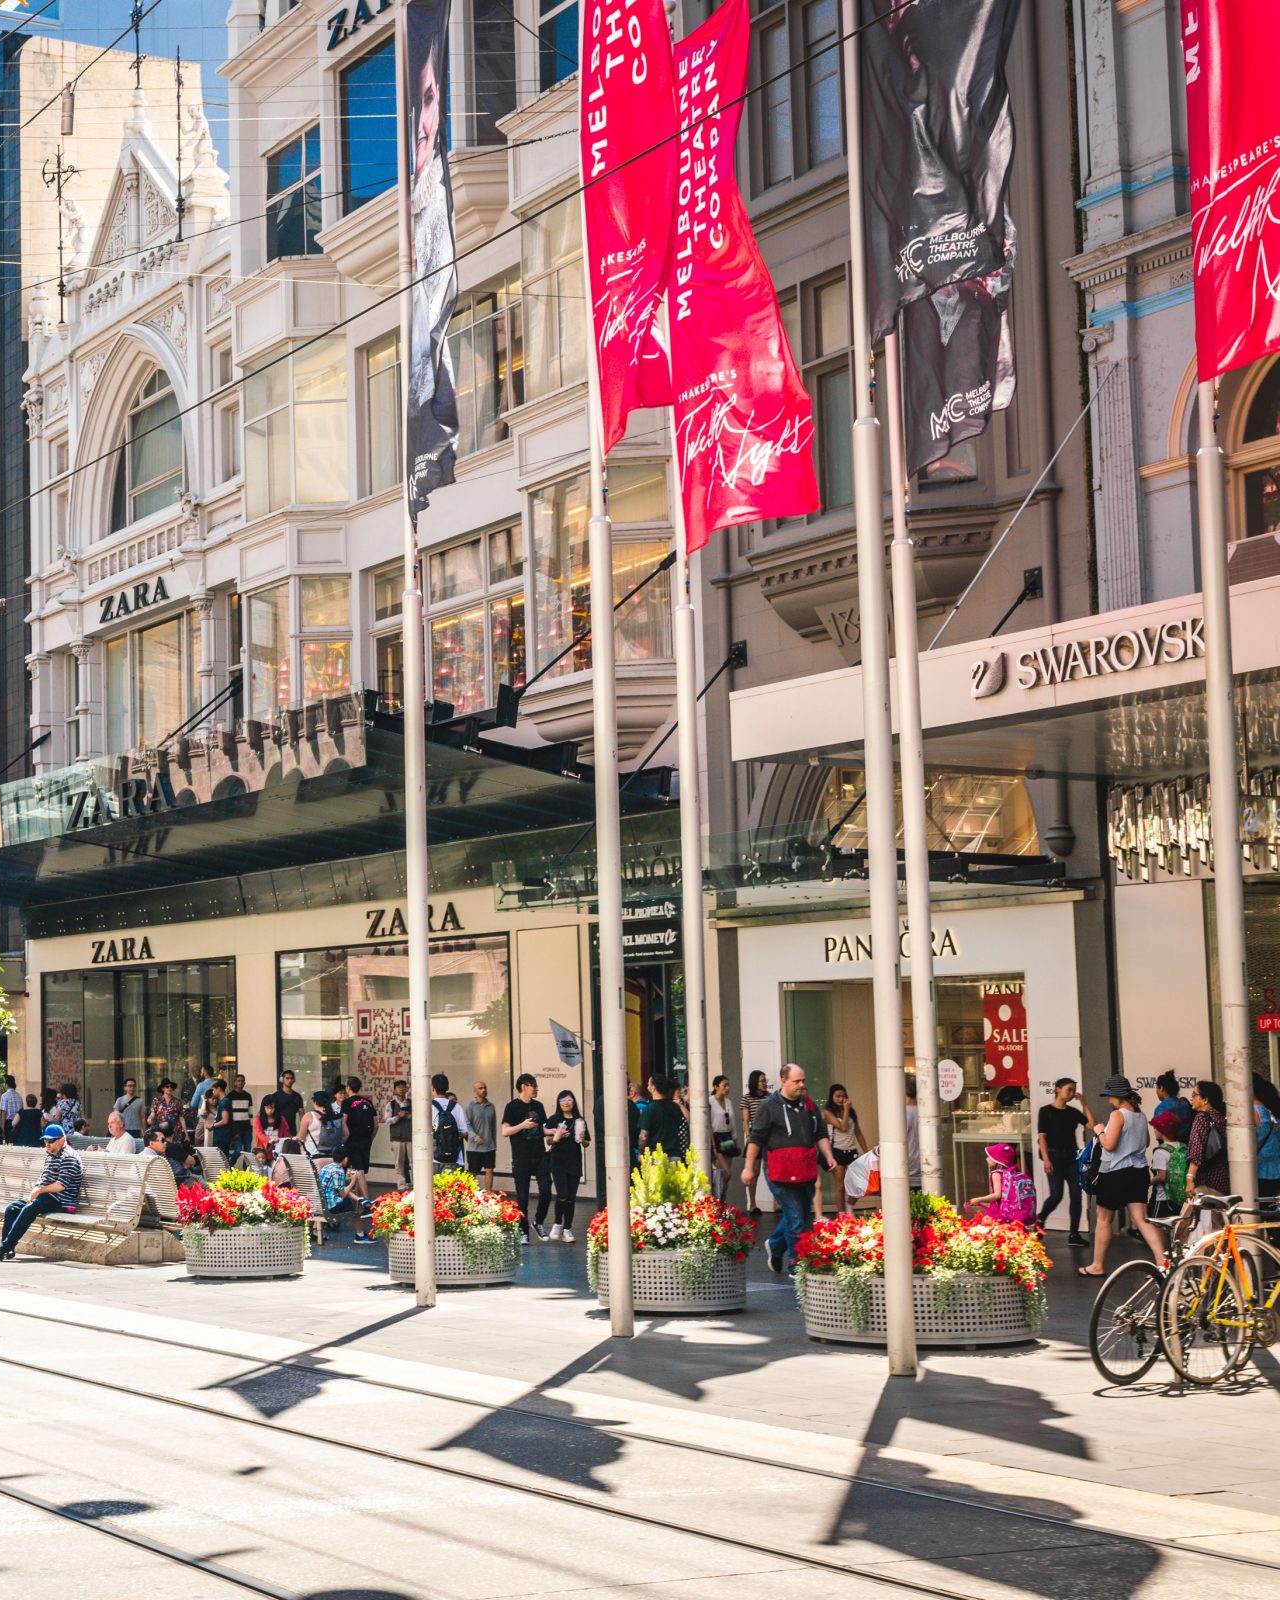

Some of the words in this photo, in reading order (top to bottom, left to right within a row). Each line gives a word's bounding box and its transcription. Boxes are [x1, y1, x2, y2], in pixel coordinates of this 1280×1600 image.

[691, 45, 707, 242] THEATRE
[704, 38, 724, 250] COMPANY
[677, 56, 693, 322] MELBOURNE
[929, 222, 987, 244] MELBOURNE
[927, 247, 980, 265] COMPANY
[929, 239, 976, 254] THEATRE
[99, 575, 171, 624] ZARA
[1017, 617, 1206, 690] SWAROVSK
[66, 771, 178, 832] ZARA
[91, 935, 155, 964] ZARA
[635, 932, 665, 946] MONEY
[992, 1028, 1028, 1043] SALE
[997, 1044, 1024, 1052] IN-STORE
[370, 1056, 404, 1076] SALE
